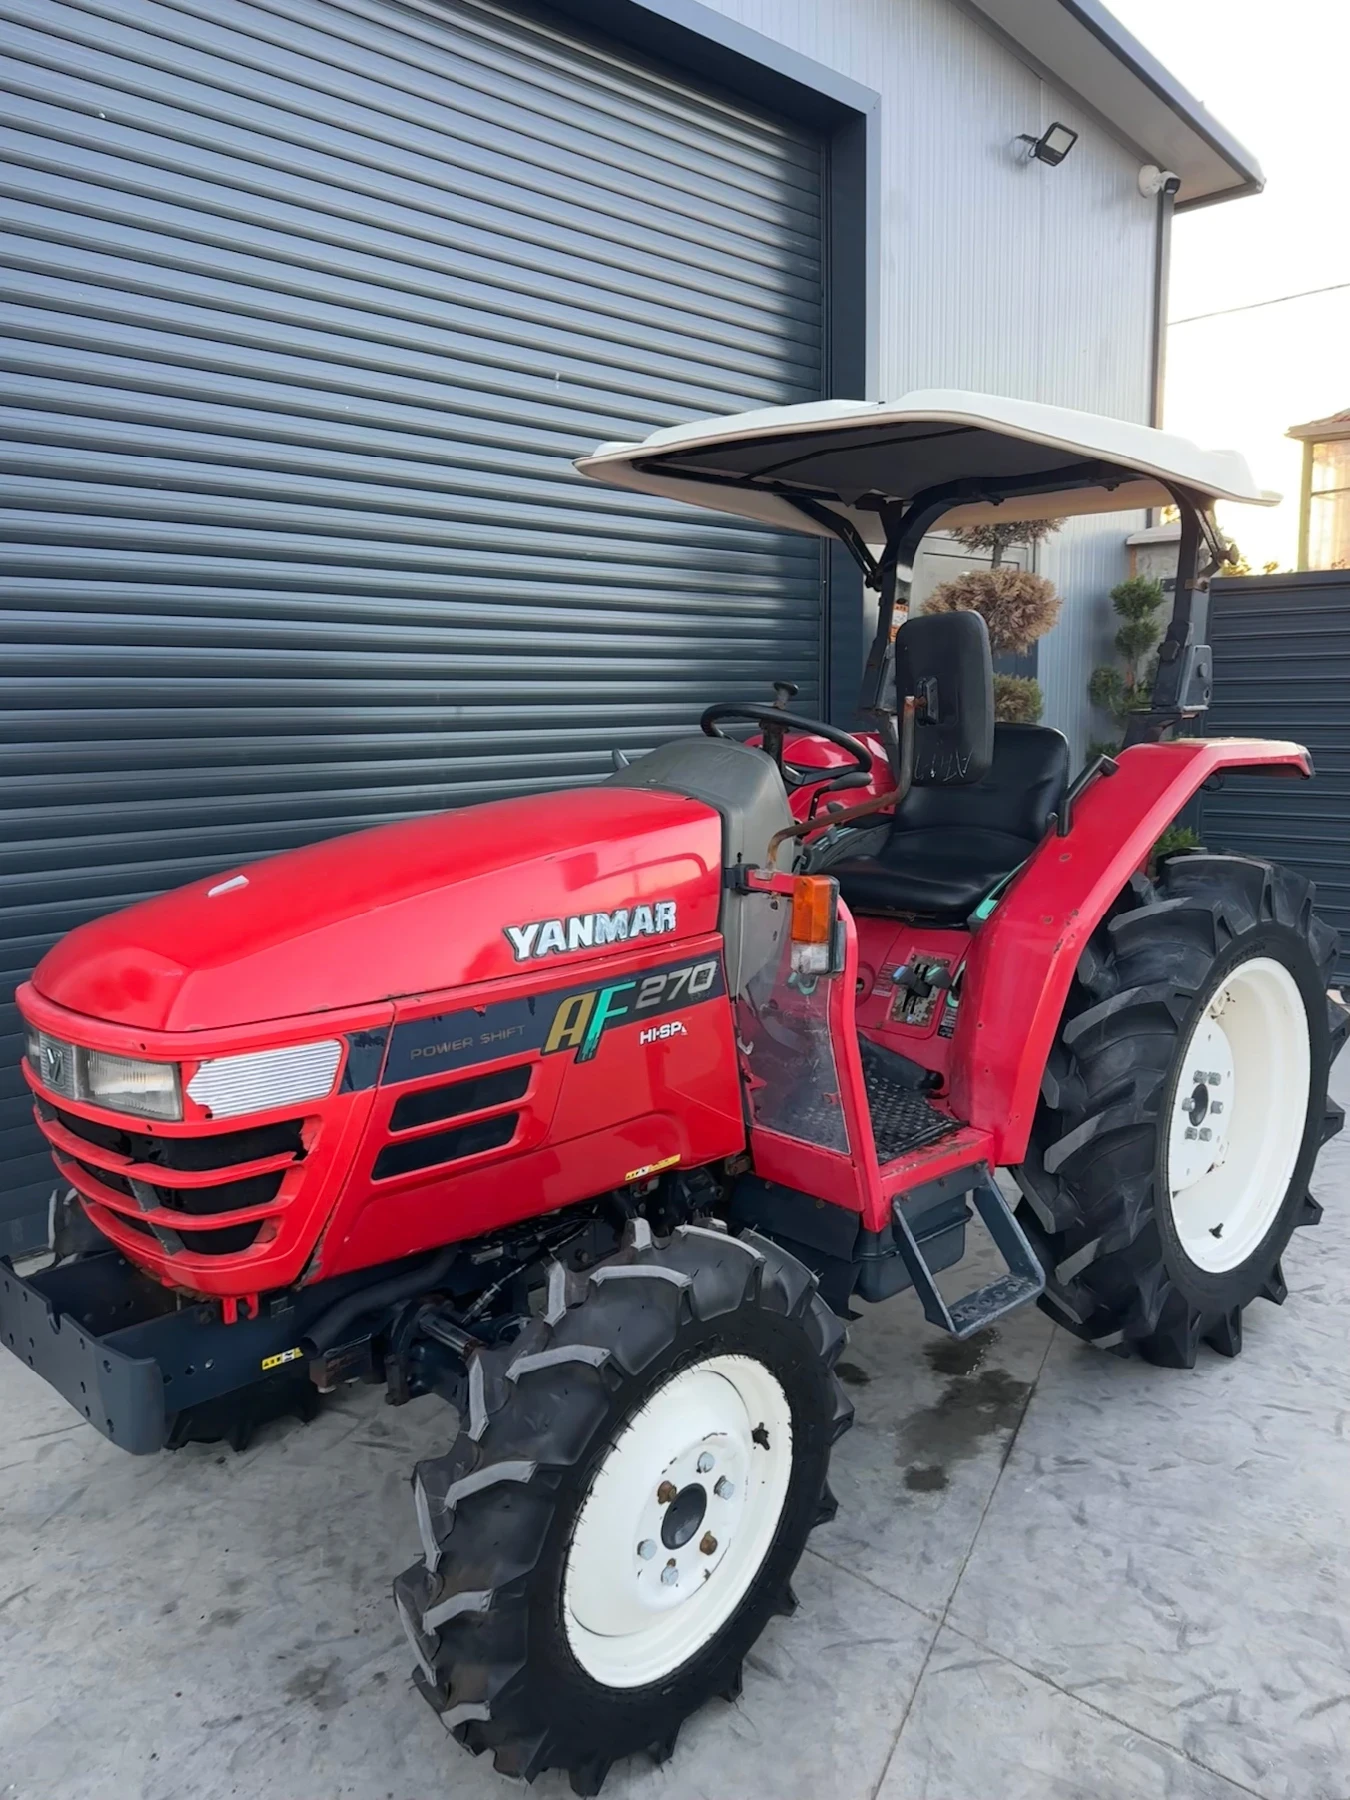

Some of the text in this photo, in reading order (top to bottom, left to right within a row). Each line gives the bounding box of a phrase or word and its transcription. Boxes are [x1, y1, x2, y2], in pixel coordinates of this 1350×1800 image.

[506, 900, 677, 960] YANMAR
[410, 1024, 526, 1060] POWER SHIFT
